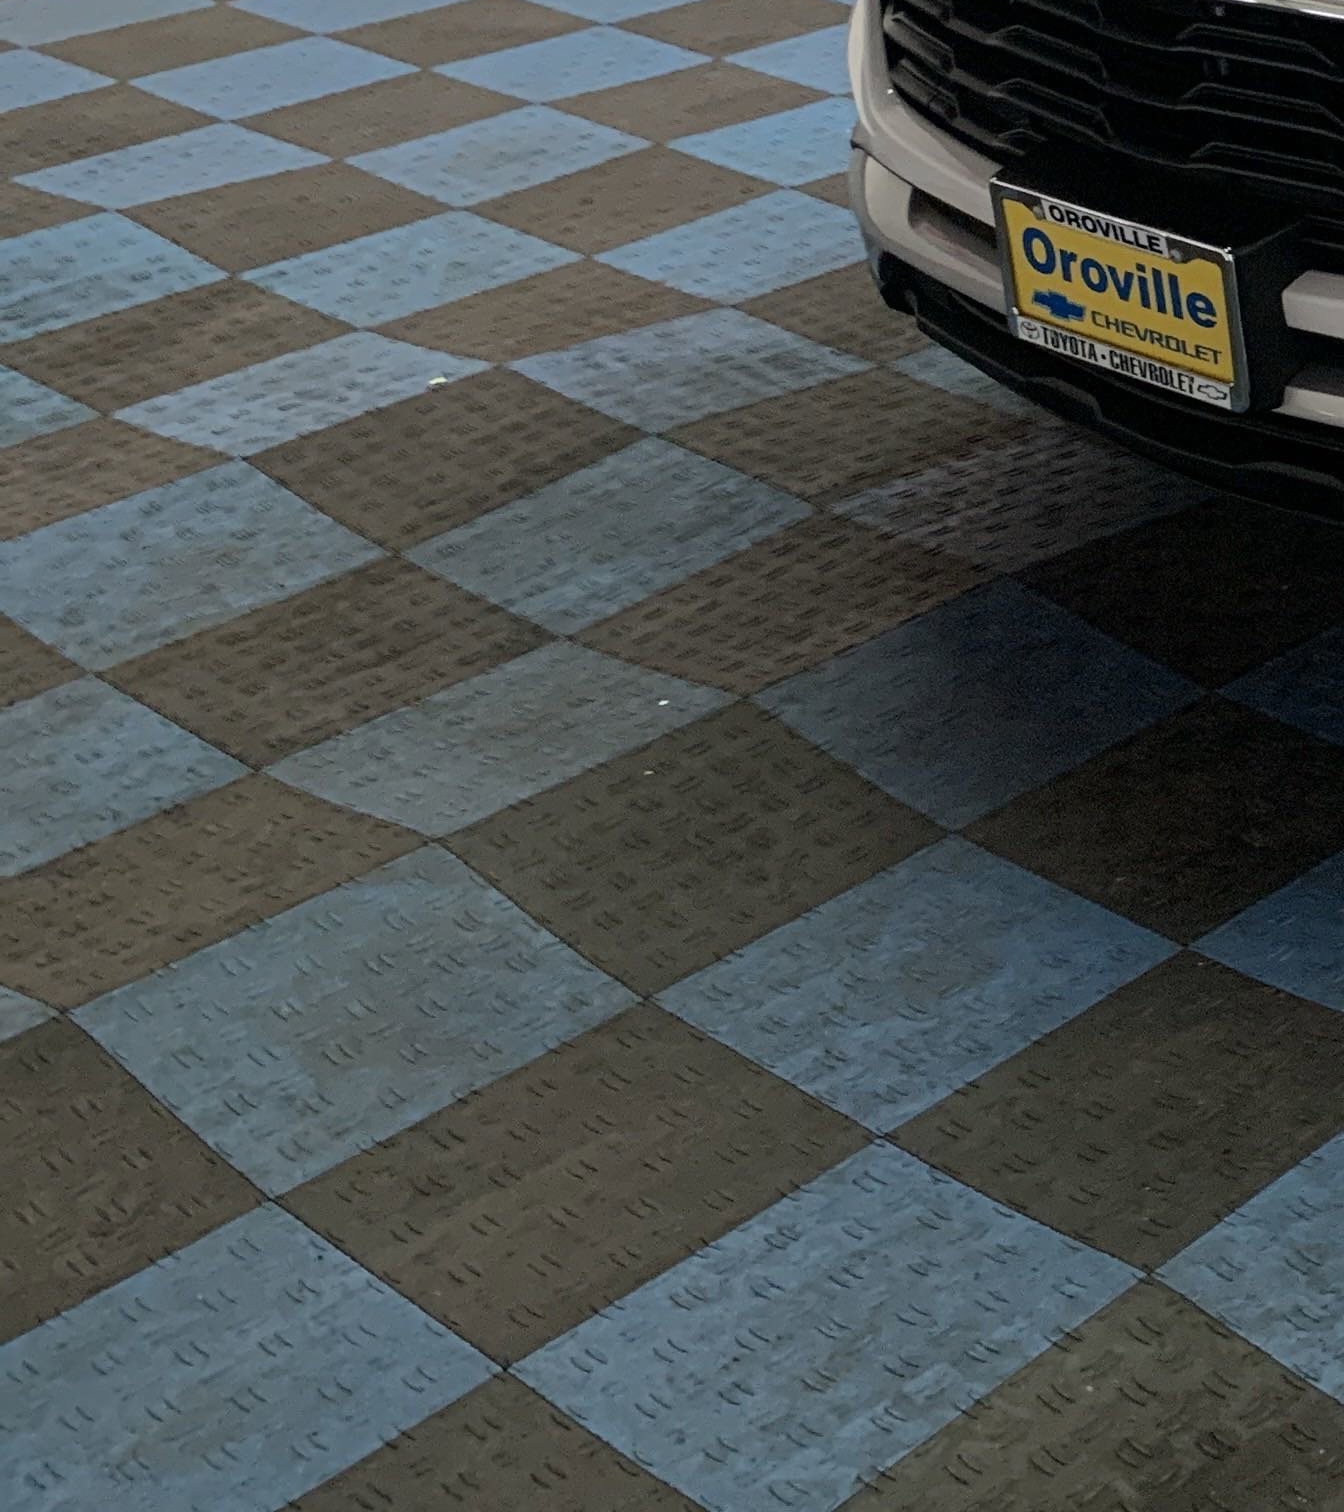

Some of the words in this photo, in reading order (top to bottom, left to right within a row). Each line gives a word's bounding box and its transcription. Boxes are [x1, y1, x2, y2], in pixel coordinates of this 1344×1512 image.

[1050, 205, 1164, 254] OROVILLE
[1022, 227, 1218, 328] Oroville
[1040, 325, 1098, 362] TOYOTA
[1109, 350, 1195, 395] CHEVROLET
[1091, 311, 1222, 365] CHEVROLET
